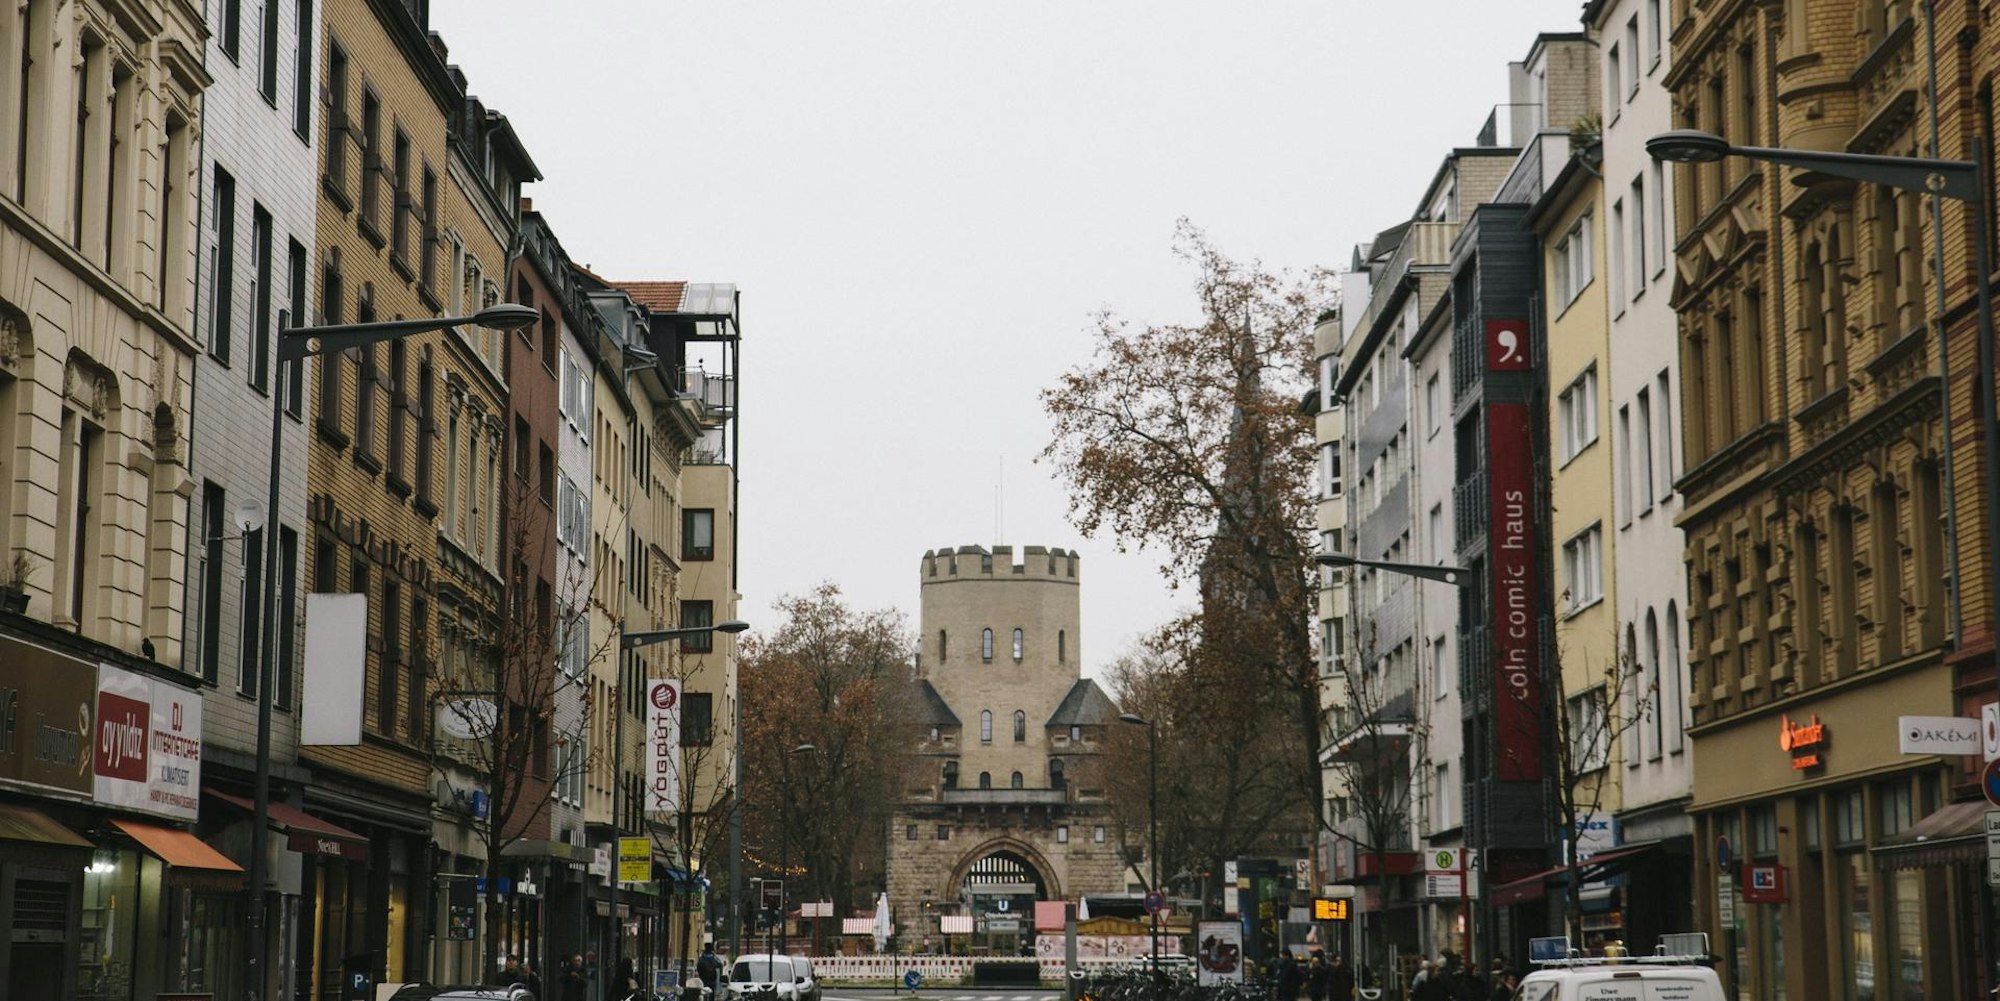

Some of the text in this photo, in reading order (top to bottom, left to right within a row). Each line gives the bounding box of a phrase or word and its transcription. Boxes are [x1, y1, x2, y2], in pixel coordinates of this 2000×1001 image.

[1501, 490, 1524, 549] haus
[1502, 565, 1526, 638] comic
[172, 702, 183, 732] DJ
[102, 720, 118, 768] ay
[998, 900, 1008, 911] U
[354, 974, 364, 988] P
[1601, 988, 1618, 996] Uwe
